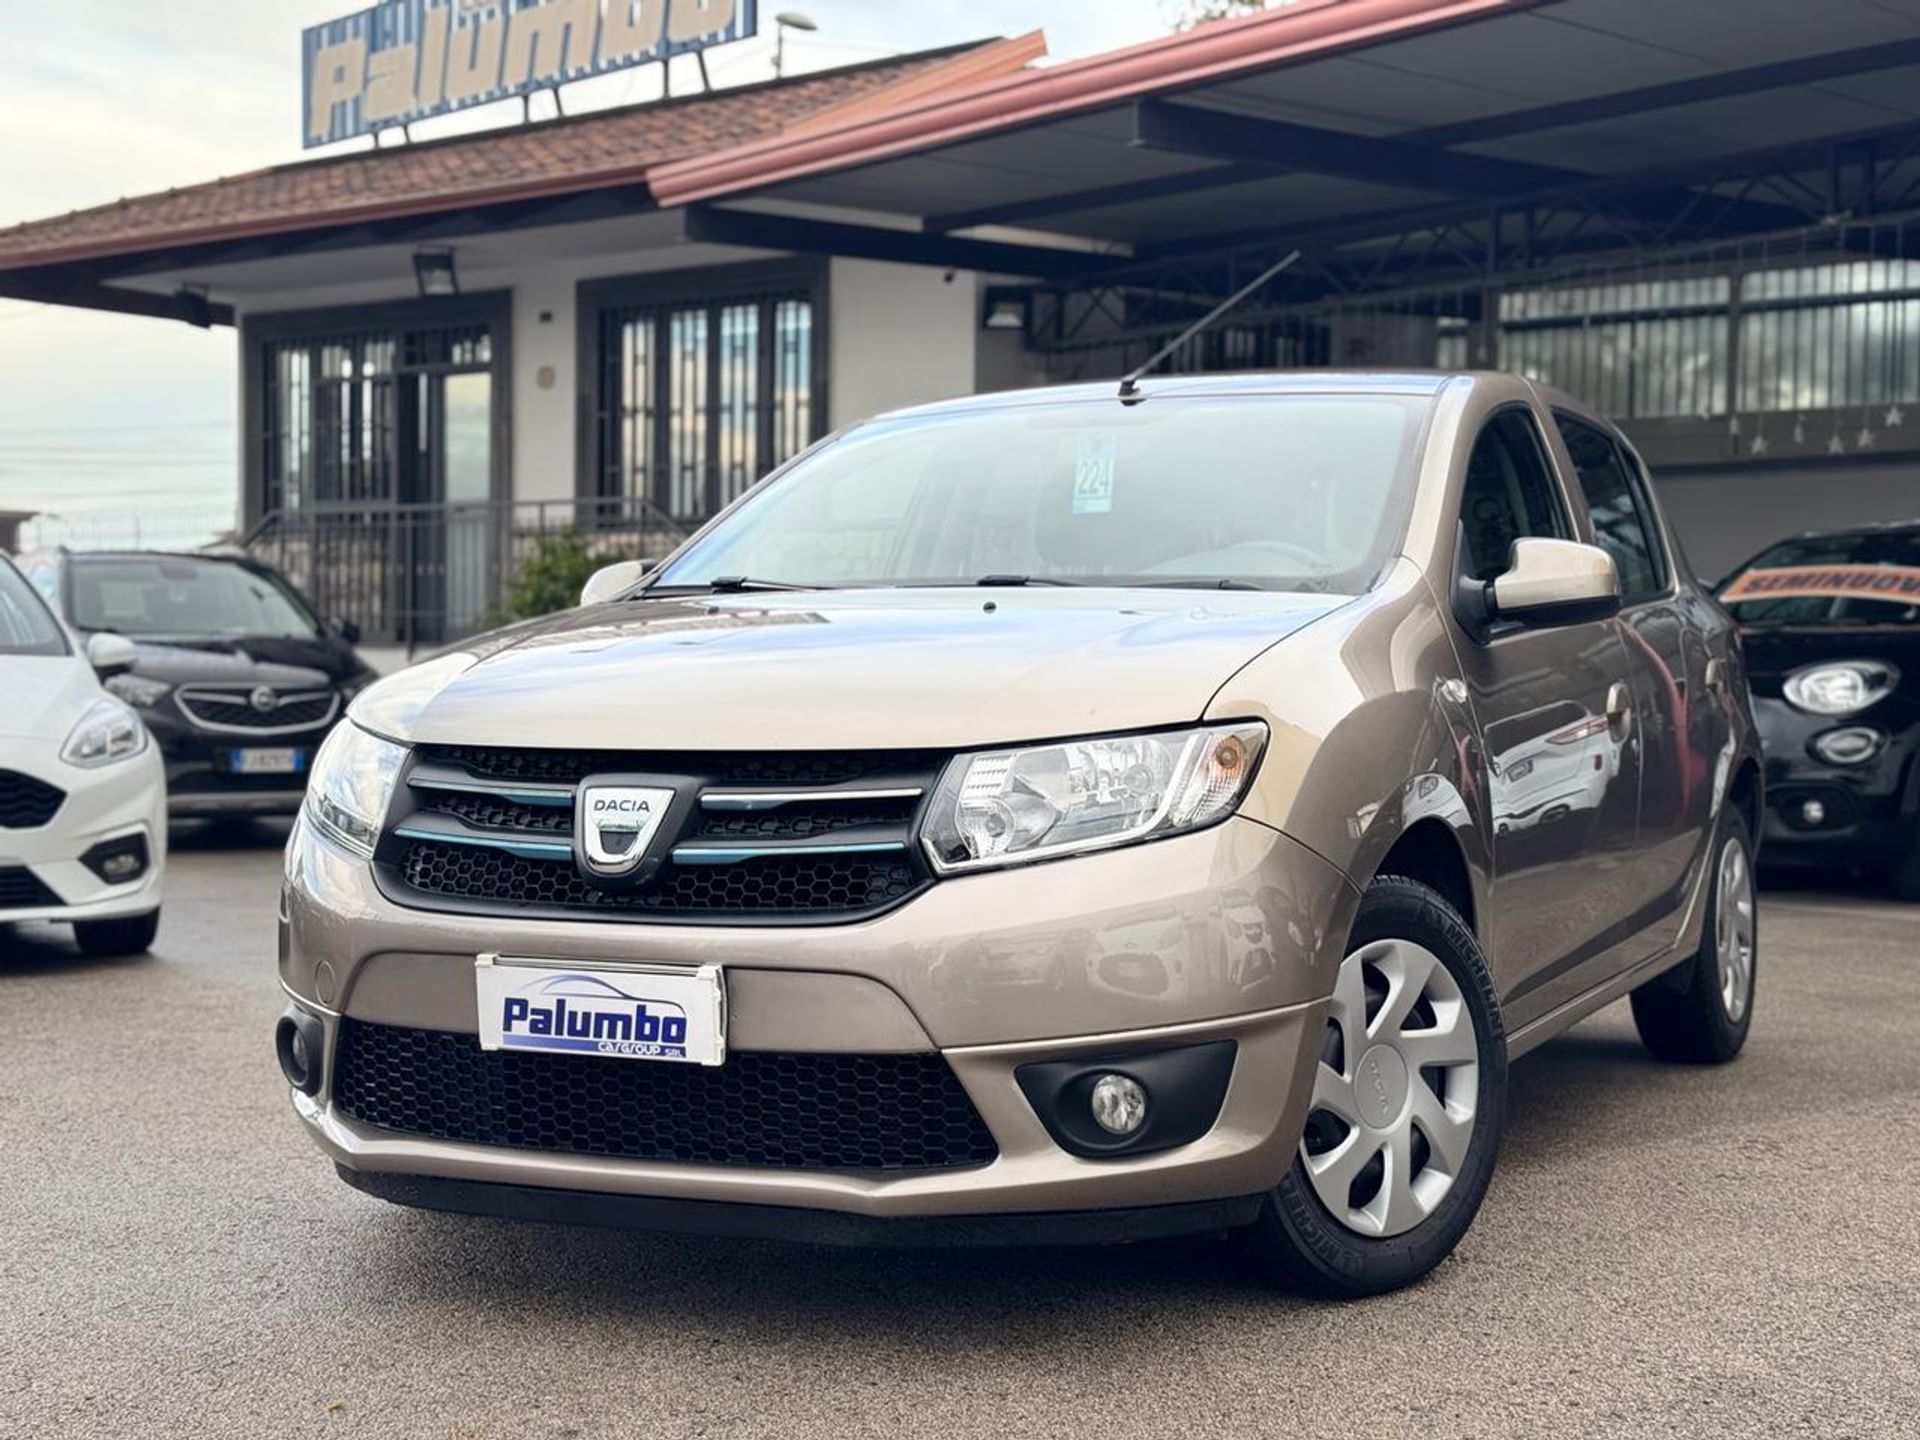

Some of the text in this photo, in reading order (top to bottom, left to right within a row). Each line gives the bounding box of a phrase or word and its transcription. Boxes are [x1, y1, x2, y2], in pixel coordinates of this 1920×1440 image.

[1077, 459, 1110, 495] 224
[593, 799, 650, 812] DACIA
[502, 997, 687, 1044] Palumbo
